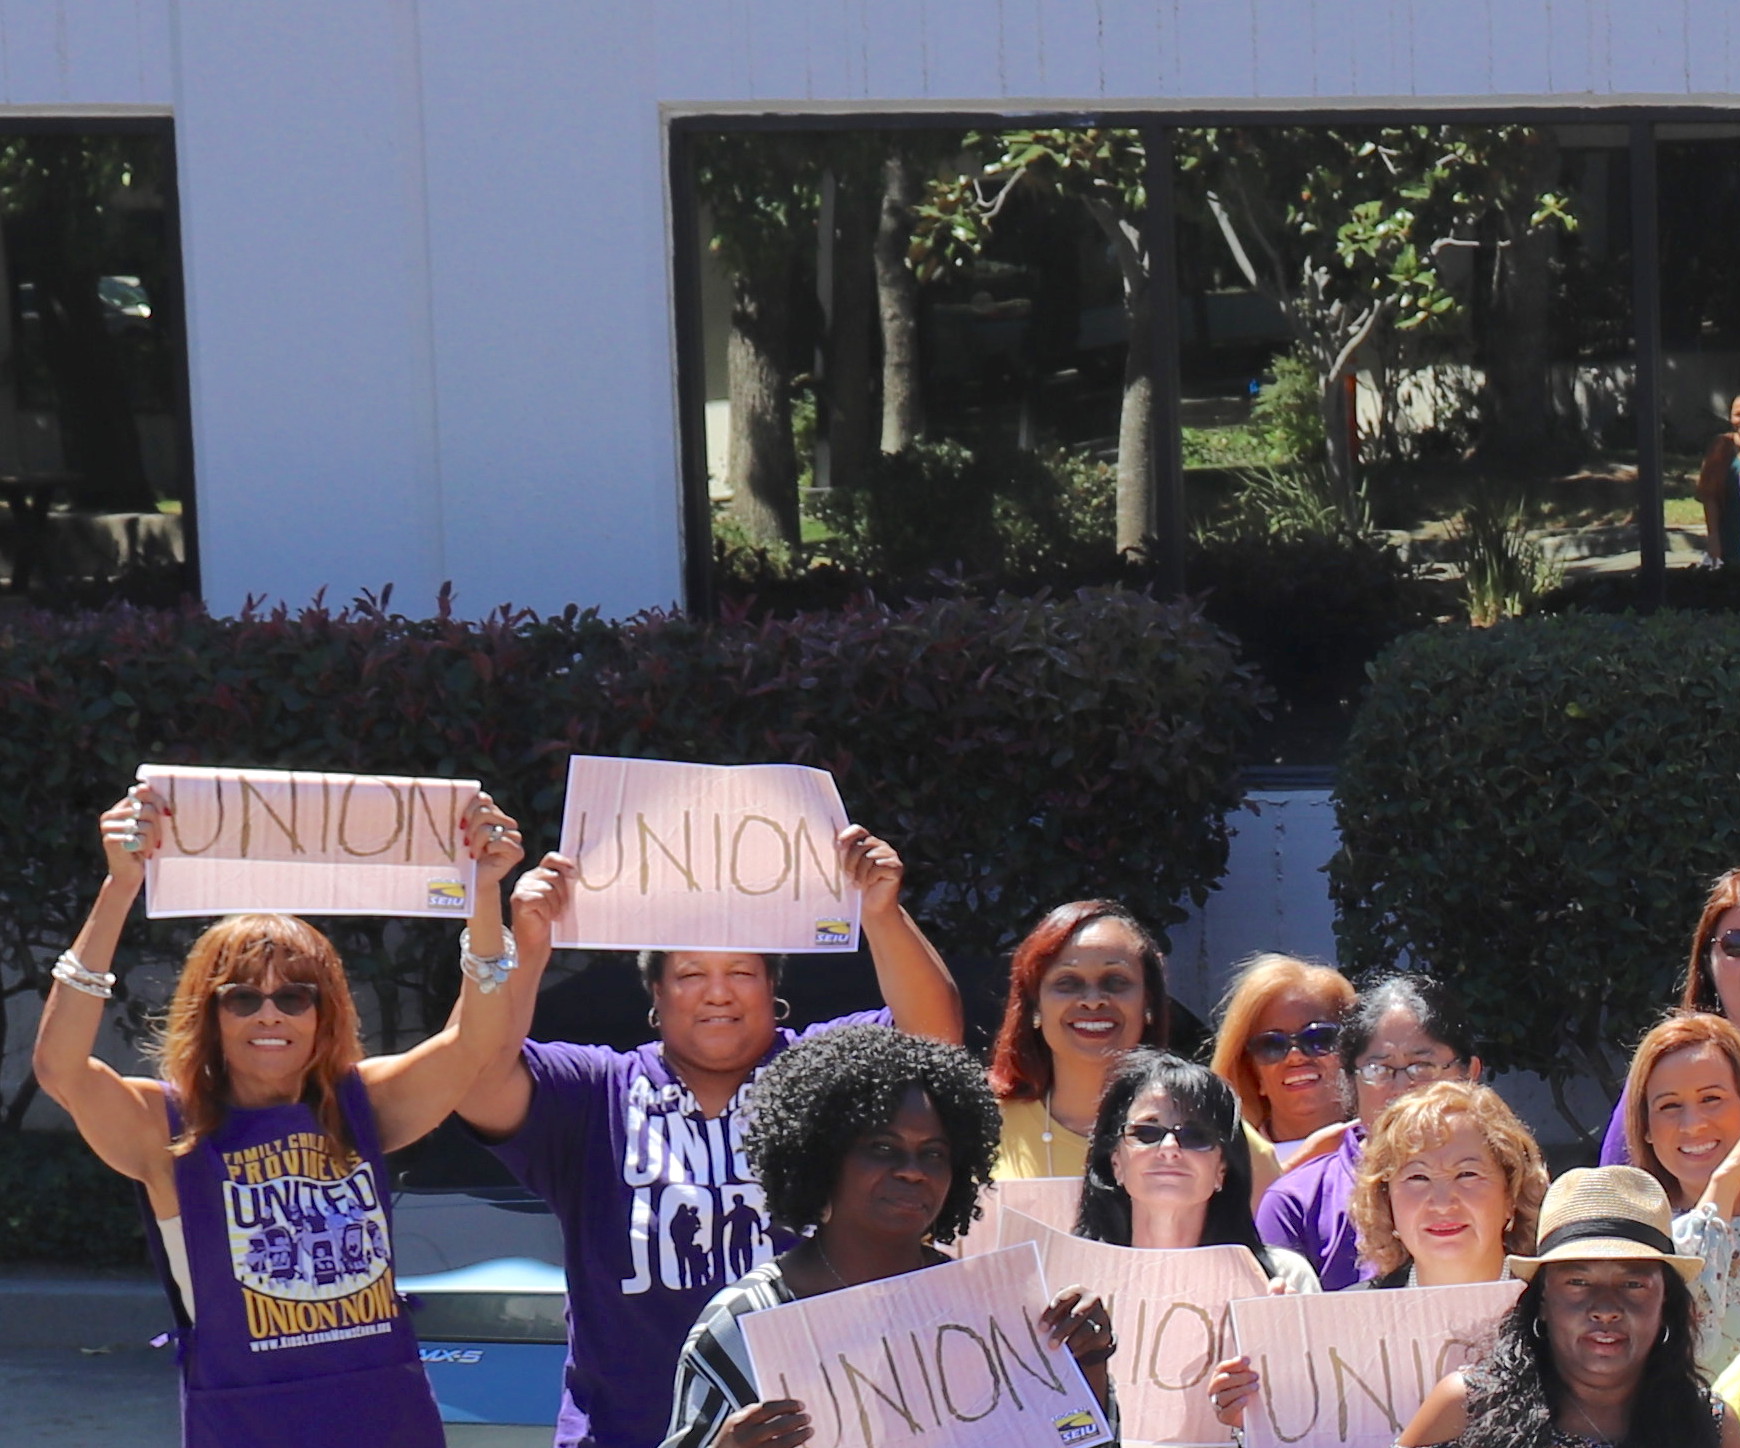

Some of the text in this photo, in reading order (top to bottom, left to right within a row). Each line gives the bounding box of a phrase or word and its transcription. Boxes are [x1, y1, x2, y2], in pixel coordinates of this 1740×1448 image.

[169, 771, 458, 862] UNION
[577, 810, 842, 902] UNION
[429, 896, 464, 905] SEIU
[816, 934, 849, 942] SEIU
[222, 1139, 282, 1164] FAMILY
[231, 1169, 377, 1233] UNITED
[241, 1287, 339, 1339] UNION
[1062, 1424, 1098, 1441] SEIU
